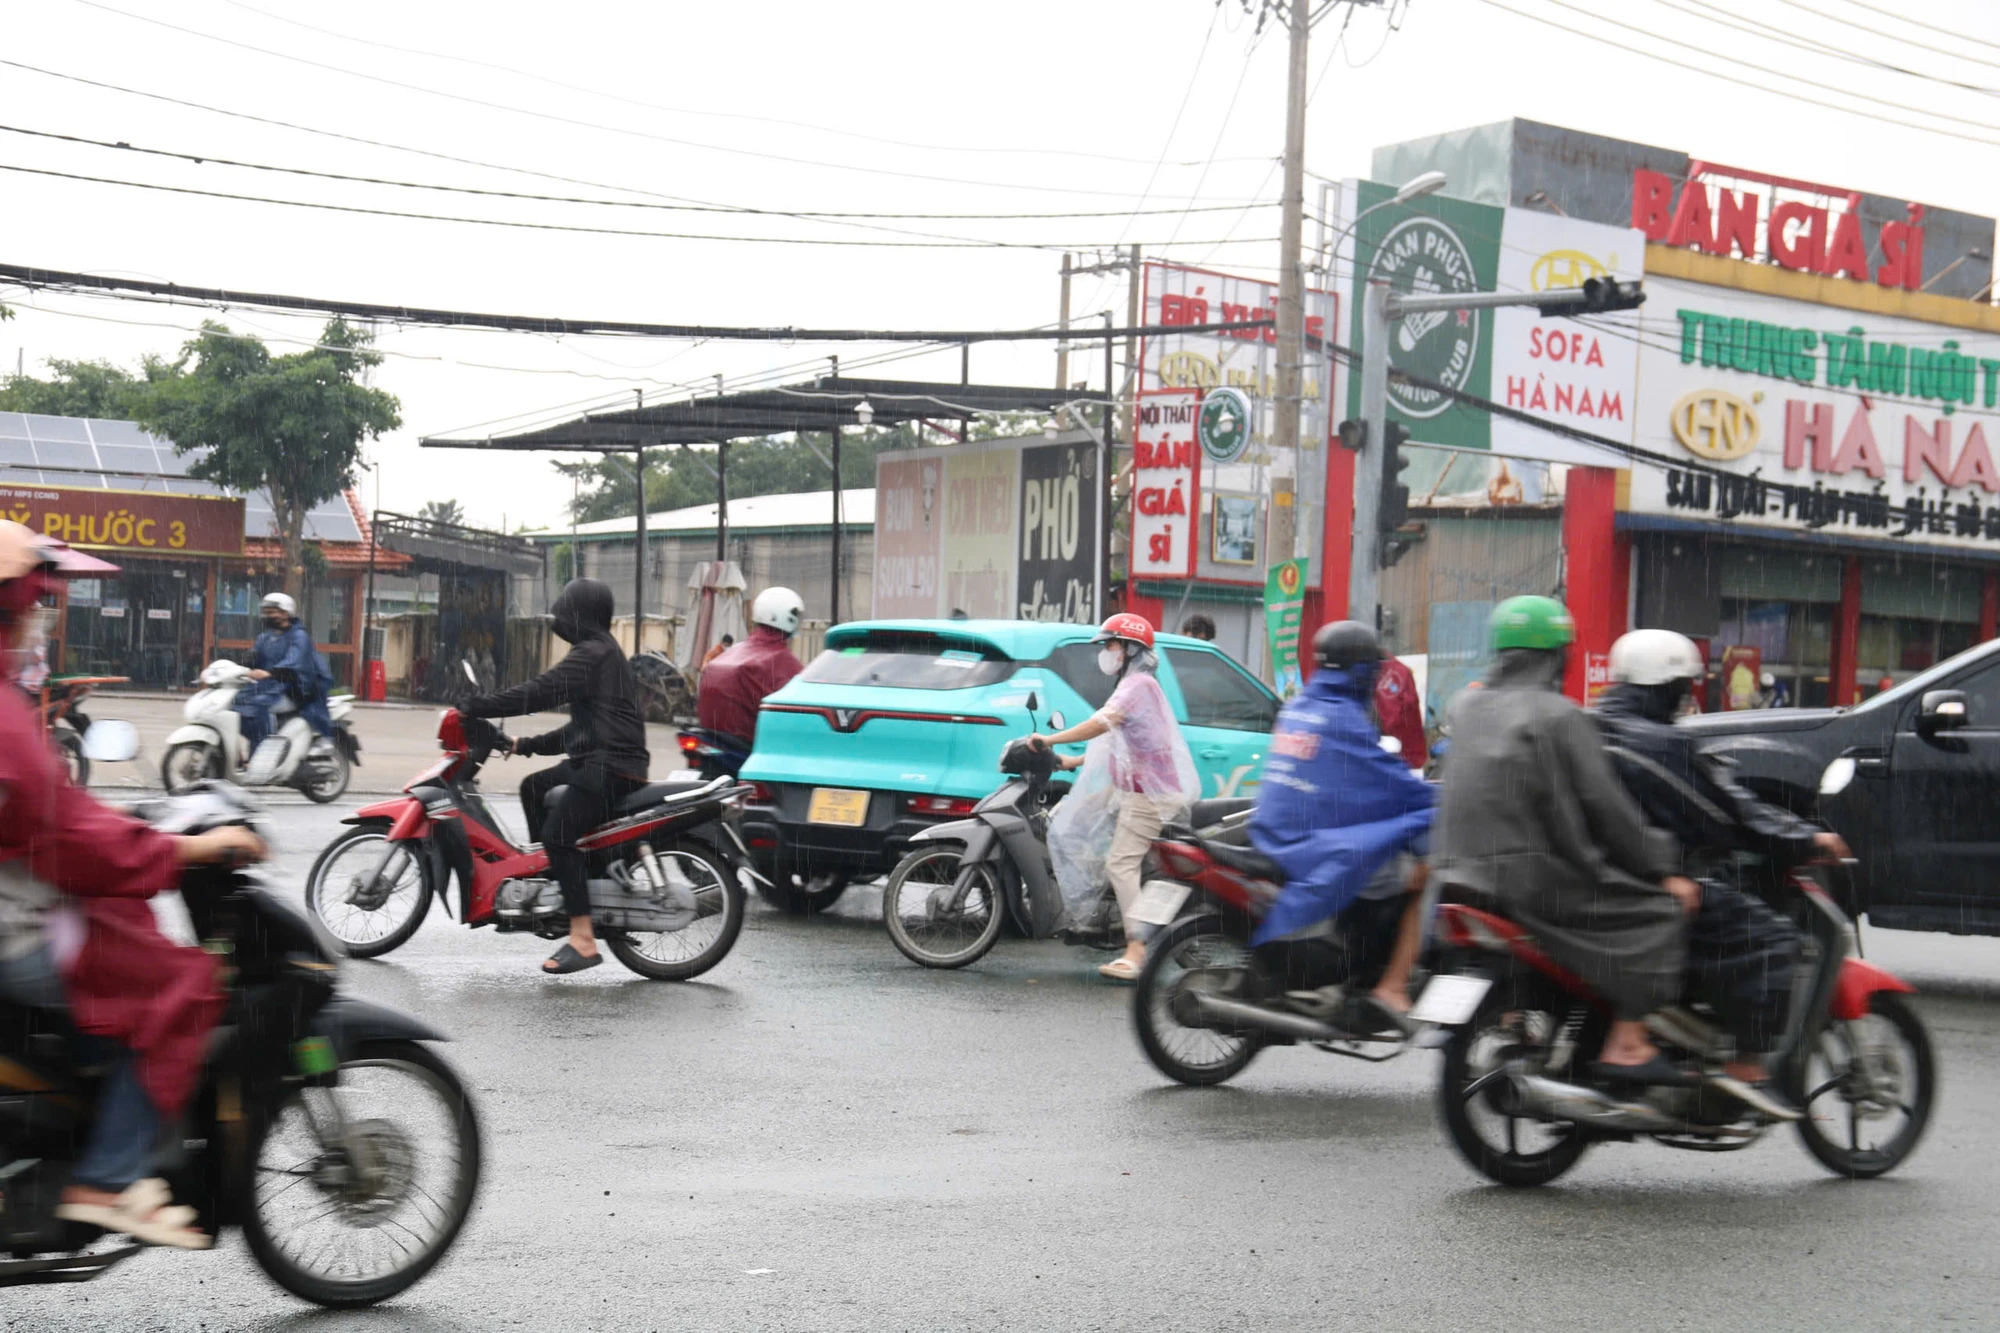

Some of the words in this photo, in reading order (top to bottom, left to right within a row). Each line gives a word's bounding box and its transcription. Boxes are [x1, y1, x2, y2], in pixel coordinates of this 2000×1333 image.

[1632, 161, 1759, 258] BÁN
[1768, 193, 1868, 281] GIÁ
[1529, 327, 1604, 367] SOFA
[1677, 309, 1818, 381] TRUNG
[1822, 326, 1907, 395] TÂM
[1909, 340, 1977, 416] NỘI
[1507, 372, 1547, 411] HÀ
[1555, 383, 1624, 422] NAM
[1135, 432, 1192, 469] BÁN
[1783, 395, 1886, 478] HÀ
[1023, 449, 1080, 561] PHỞ
[1137, 479, 1186, 516] GIÁ
[44, 509, 156, 546] PHƯỚC
[168, 521, 187, 548] 3
[1149, 524, 1172, 563] SỈ
